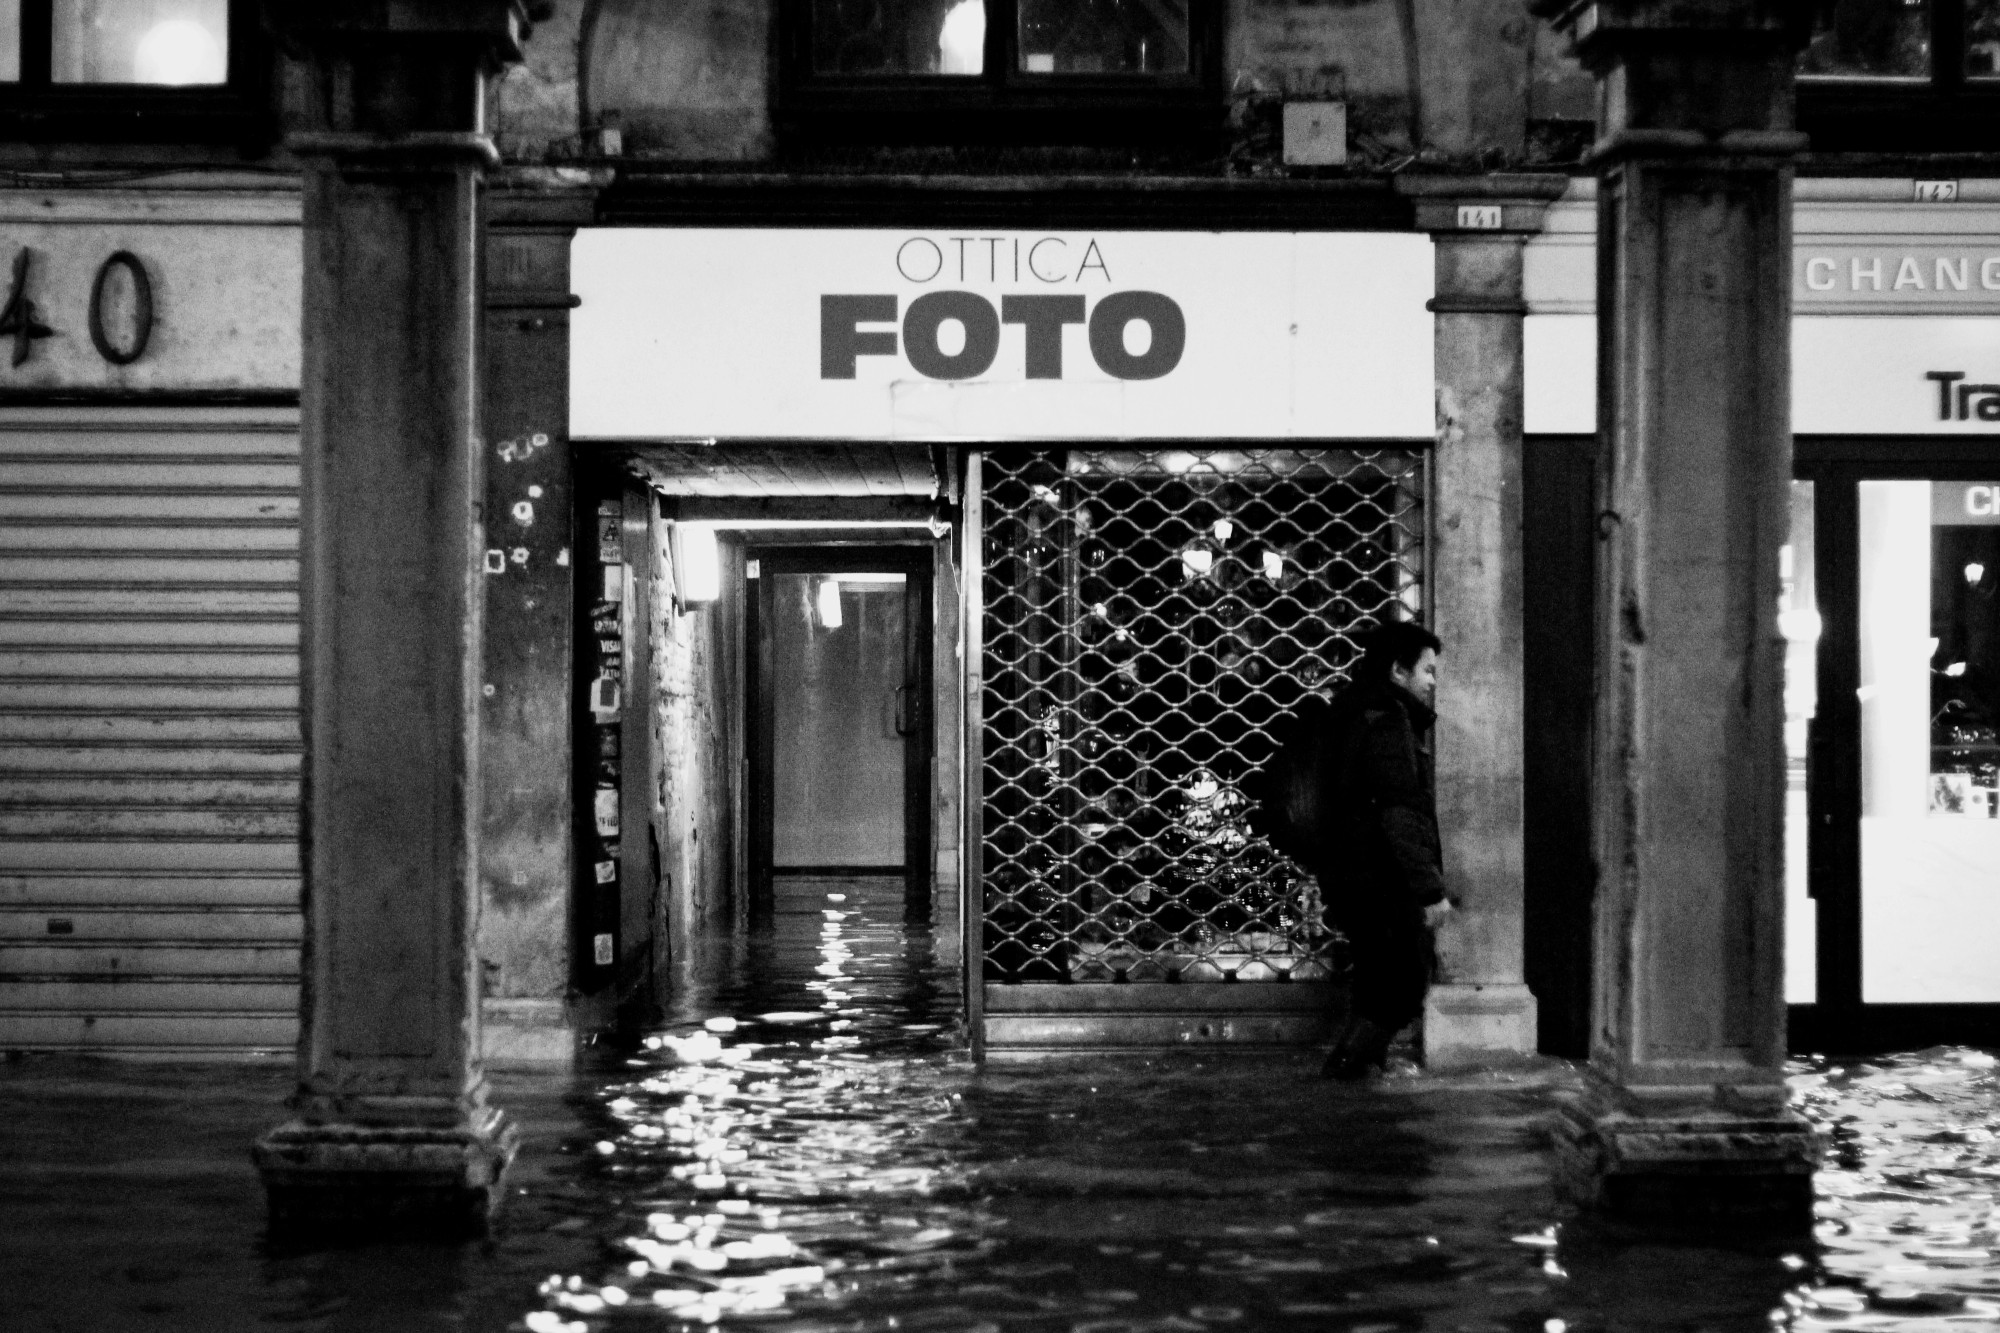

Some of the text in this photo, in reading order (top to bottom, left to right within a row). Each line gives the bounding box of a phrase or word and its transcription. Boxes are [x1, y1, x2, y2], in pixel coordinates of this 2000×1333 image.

[1919, 184, 1954, 202] 142
[1462, 210, 1496, 226] 141
[896, 237, 1111, 283] OTTICA
[820, 290, 1186, 381] FOTO
